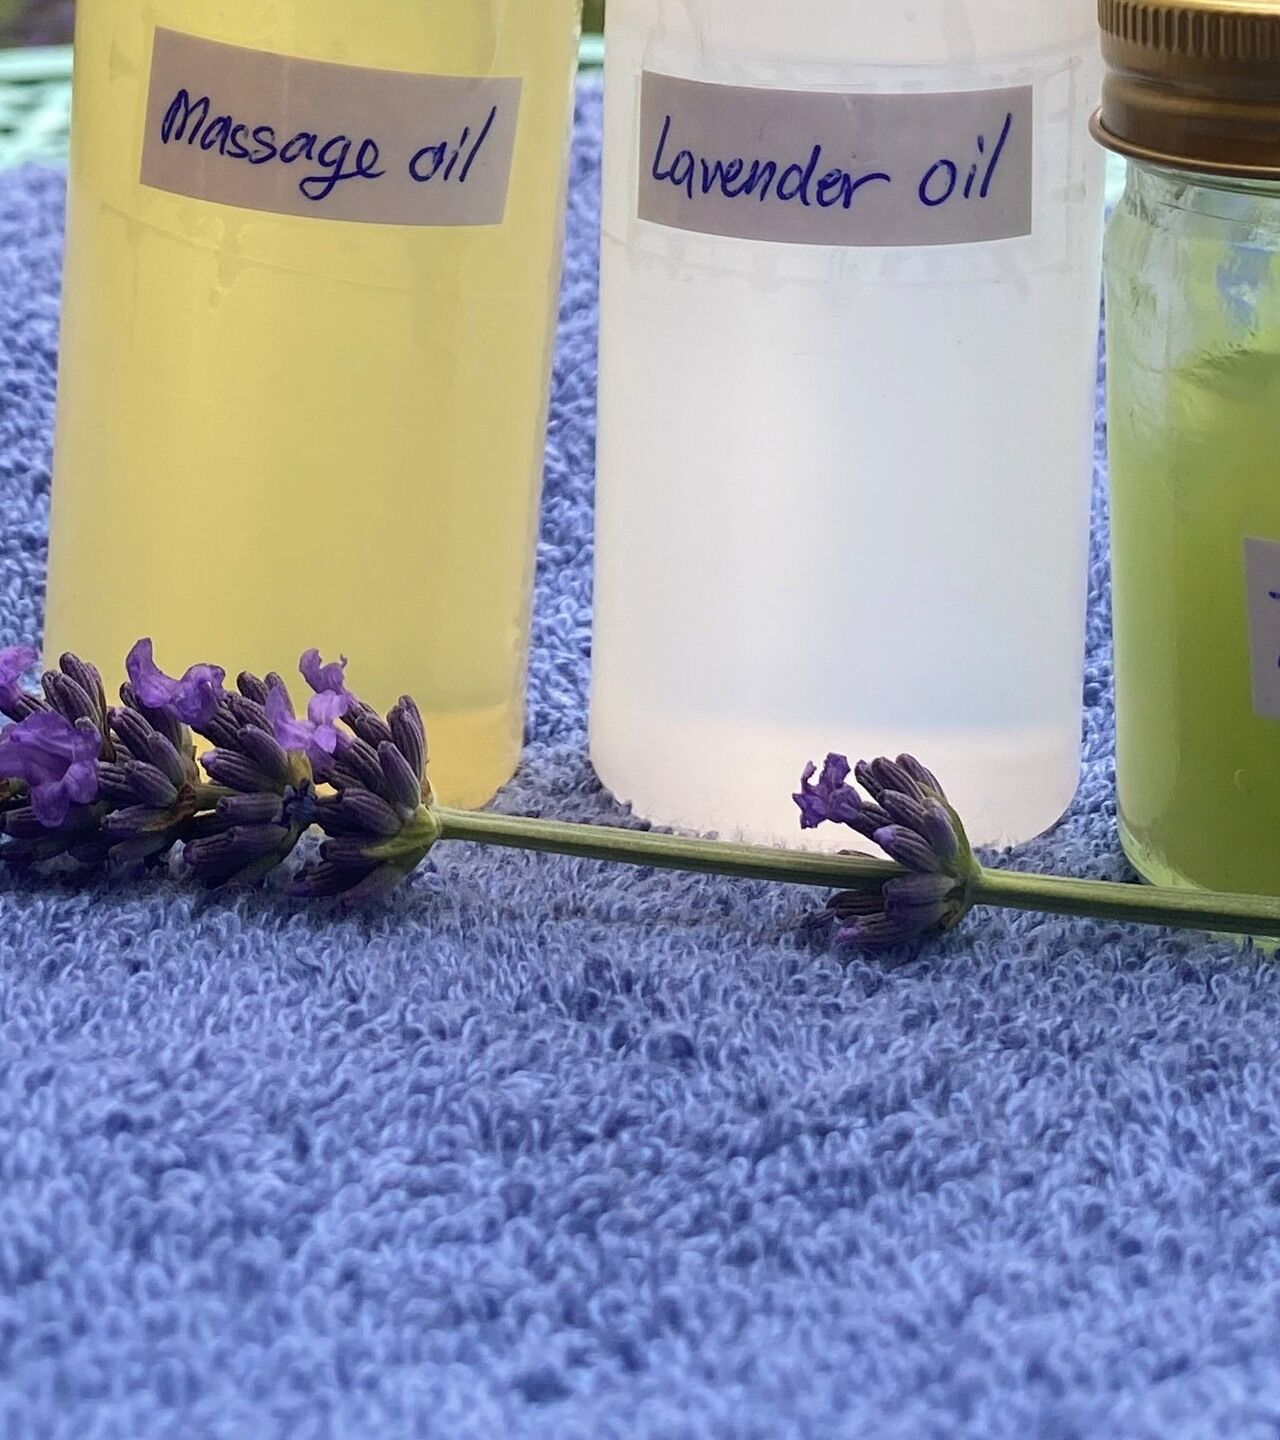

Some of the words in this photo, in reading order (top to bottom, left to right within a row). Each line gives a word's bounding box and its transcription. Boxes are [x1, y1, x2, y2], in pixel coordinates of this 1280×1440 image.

[160, 88, 386, 200] Massage
[408, 105, 498, 183] oil
[919, 112, 1013, 207] oil
